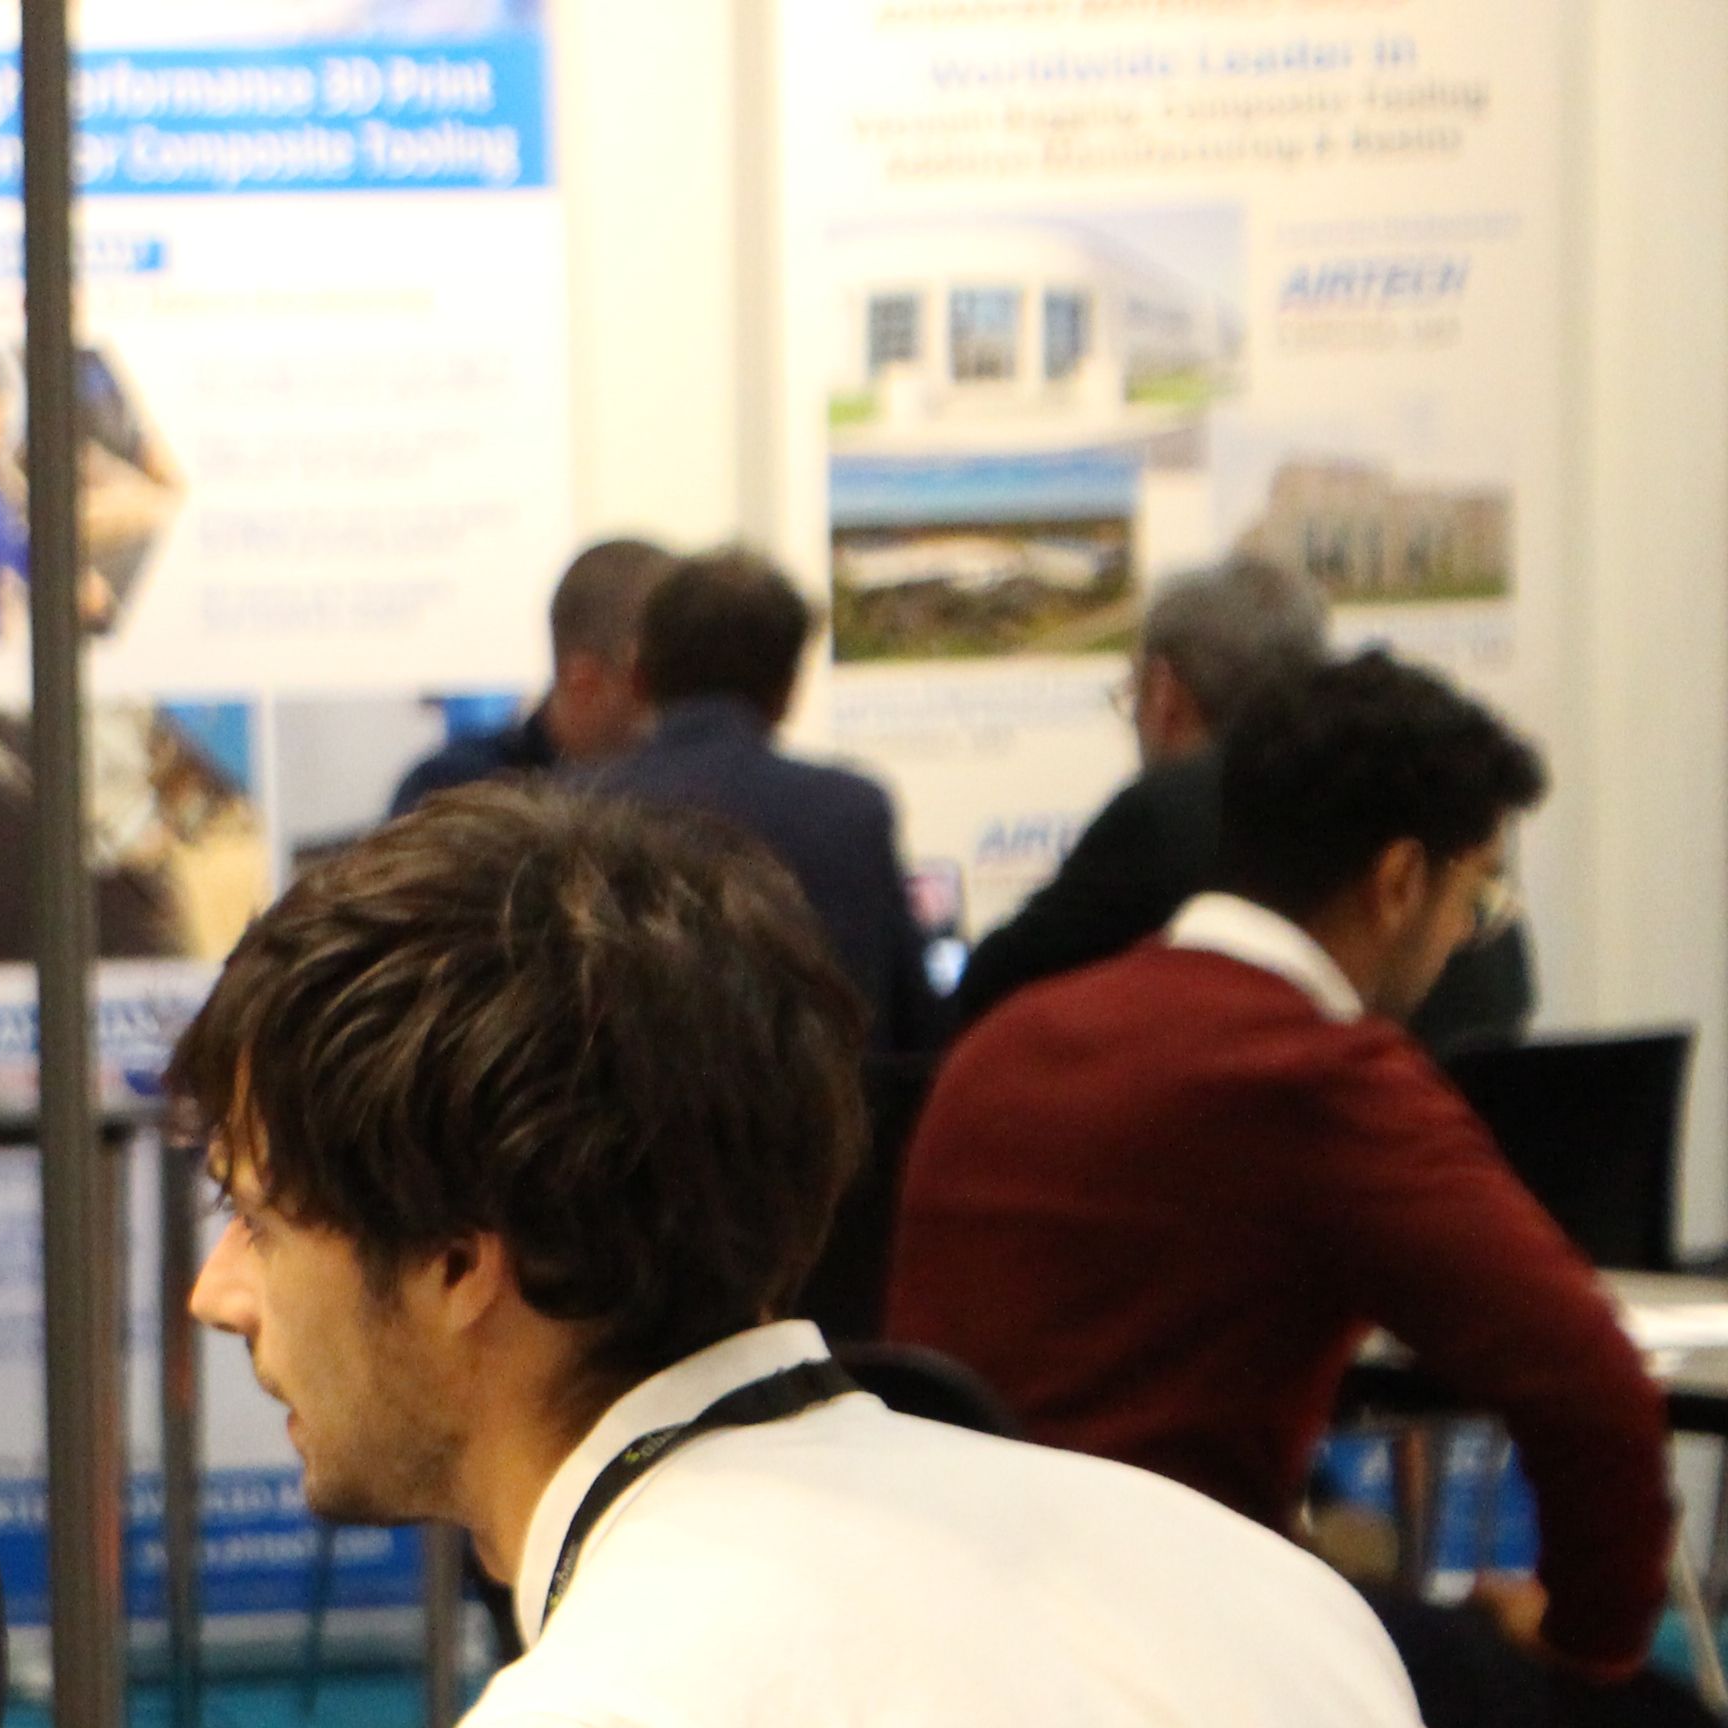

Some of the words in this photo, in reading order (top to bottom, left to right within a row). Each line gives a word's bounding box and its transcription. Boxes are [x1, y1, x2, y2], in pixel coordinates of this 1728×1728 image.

[70, 58, 316, 120] erformance
[324, 56, 384, 116] 3D
[386, 55, 496, 114] Print
[126, 120, 356, 190] Composite
[360, 118, 524, 188] Tooling
